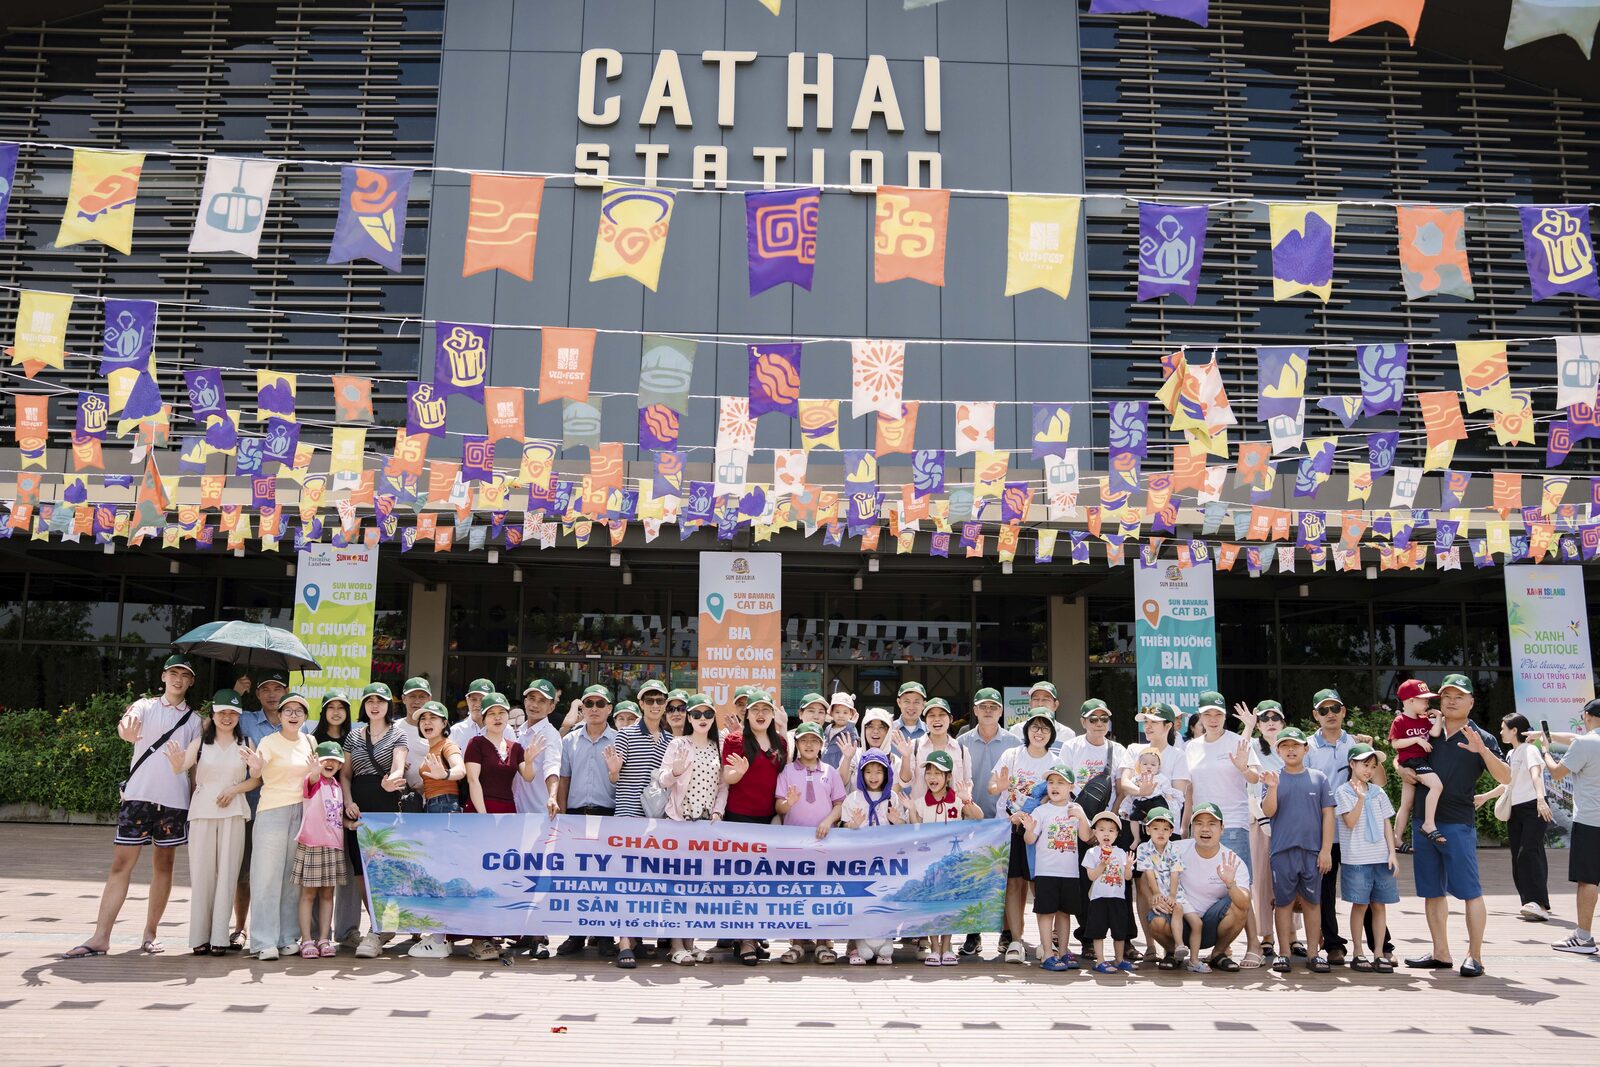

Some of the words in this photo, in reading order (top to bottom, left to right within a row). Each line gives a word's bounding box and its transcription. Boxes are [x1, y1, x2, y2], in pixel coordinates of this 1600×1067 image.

[577, 48, 758, 129] CAT
[787, 52, 942, 133] HAI
[574, 143, 942, 194] STATION
[332, 582, 347, 590] SUN
[348, 582, 373, 590] WORLD
[332, 591, 351, 600] CAT
[353, 592, 368, 601] BA
[733, 592, 747, 600] SUN
[747, 592, 776, 600] BAVARIA
[736, 600, 757, 610] CAT
[759, 600, 774, 610] BA
[1171, 607, 1191, 616] CAT
[1193, 607, 1207, 616] BA
[300, 622, 314, 635] DI
[728, 626, 751, 640] BIA
[1139, 634, 1171, 647] THIÊN
[1534, 631, 1565, 642] XANH
[341, 642, 367, 658] TIỆN
[705, 644, 733, 661] THỦ
[736, 645, 774, 661] CÔNG
[1524, 643, 1579, 655] BOUTIQUE
[1161, 651, 1193, 670] BIA
[326, 666, 360, 680] TRỌN
[701, 665, 749, 679] NGUYÊN
[751, 666, 776, 680] BẢN
[1164, 673, 1188, 687] GIẢI
[607, 833, 679, 850] CHÀO
[688, 838, 768, 853] MỪNG
[482, 848, 565, 871] CÔNG
[575, 853, 612, 872] TY
[621, 854, 703, 876] TNHH
[713, 856, 816, 876] HOÀNG
[826, 856, 909, 876] NGÂN
[552, 879, 608, 892] THAM
[614, 880, 667, 894] QUAN
[732, 881, 770, 895] ĐẢO
[776, 881, 815, 895] CÁT
[820, 881, 846, 895] BÀ
[549, 898, 570, 912] DI
[576, 896, 619, 913] SẢN
[625, 898, 688, 914] THIÊN
[695, 900, 758, 915] NHIÊN
[766, 899, 808, 916] THẾ
[811, 901, 853, 916] GIỚI
[578, 918, 605, 927] Đơn
[609, 919, 621, 928] vị
[625, 917, 640, 927] tổ
[644, 918, 681, 928] chức:
[685, 920, 716, 929] TAM
[720, 921, 754, 929] SINH
[758, 921, 813, 930] TRAVEL
